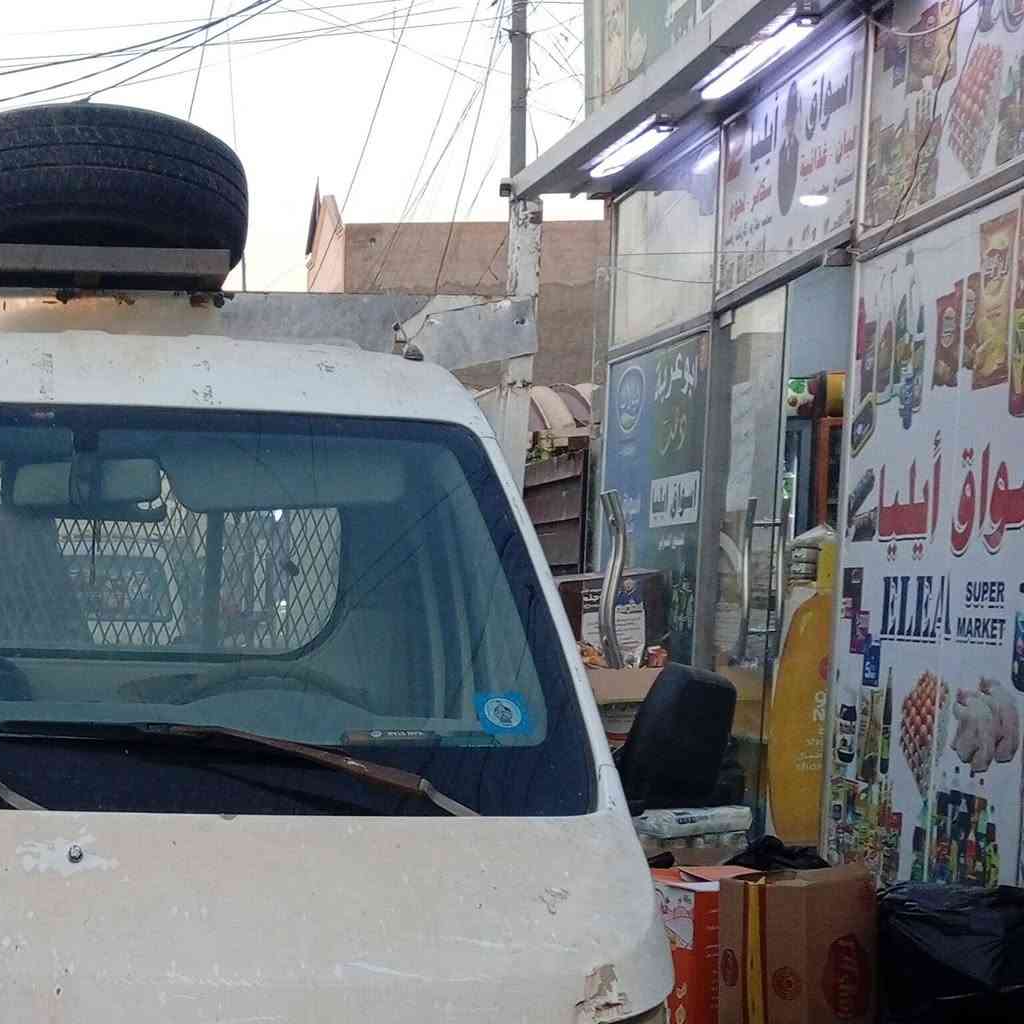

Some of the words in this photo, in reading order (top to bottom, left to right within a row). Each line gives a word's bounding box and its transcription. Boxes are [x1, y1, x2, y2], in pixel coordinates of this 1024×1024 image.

[965, 580, 1006, 604] SUPER
[879, 570, 952, 640] ELEA
[956, 616, 1007, 641] MARKET
